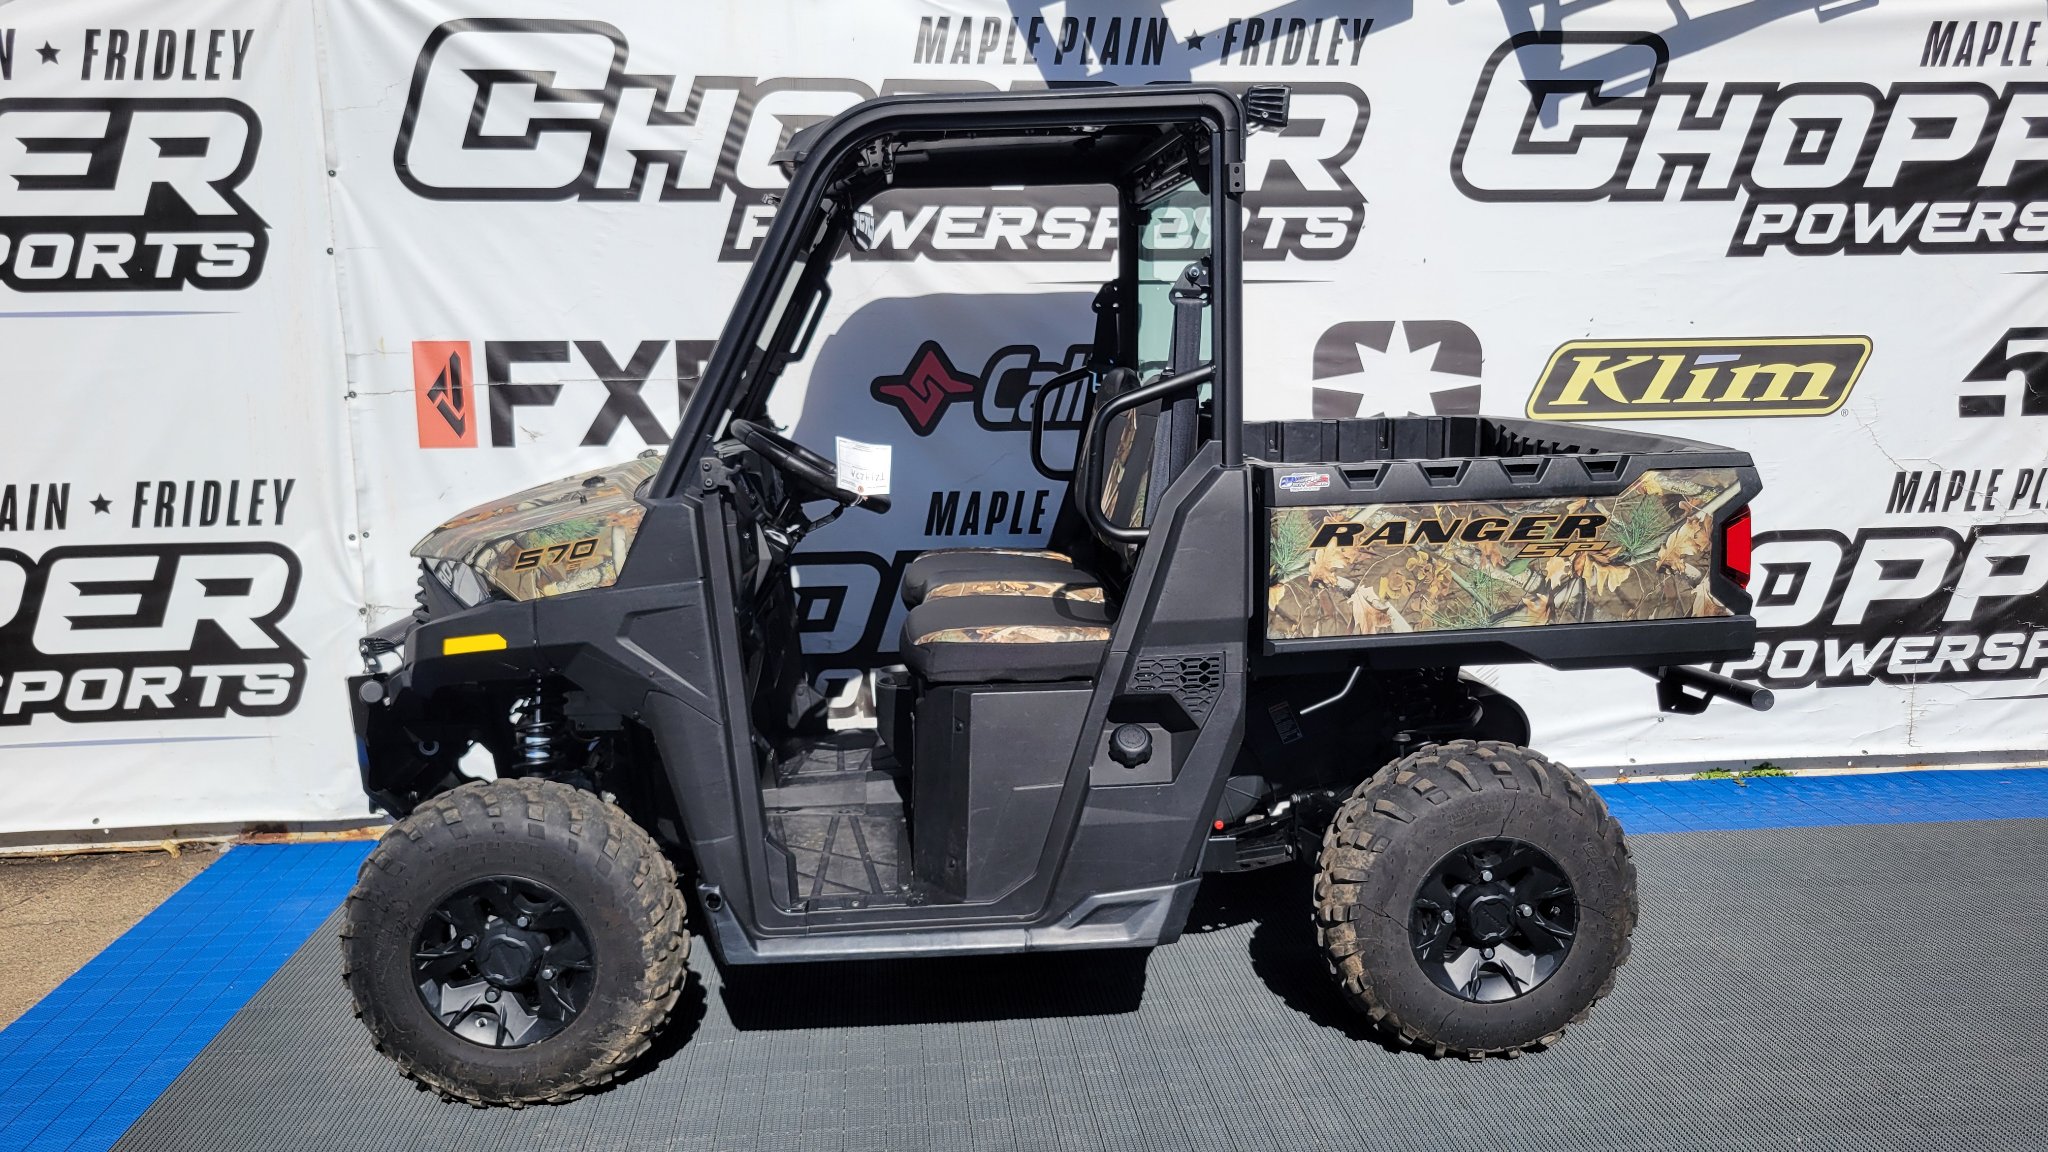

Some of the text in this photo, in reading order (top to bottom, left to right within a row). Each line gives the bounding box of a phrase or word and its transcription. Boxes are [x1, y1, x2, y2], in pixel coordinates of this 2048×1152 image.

[81, 29, 255, 80] FRIDLEY
[913, 16, 1375, 66] MAPLE PLAIN FRIDLEY
[1919, 20, 2042, 67] MAPLE
[1548, 353, 1837, 406] Klim
[131, 478, 296, 528] FRIDLEY
[924, 490, 1050, 536] MAPLE
[1885, 468, 2004, 514] MAPLE
[1308, 513, 1610, 548] RANGER
[1512, 540, 1612, 560] SP
[514, 537, 601, 573] 570
[0, 545, 303, 658] ER
